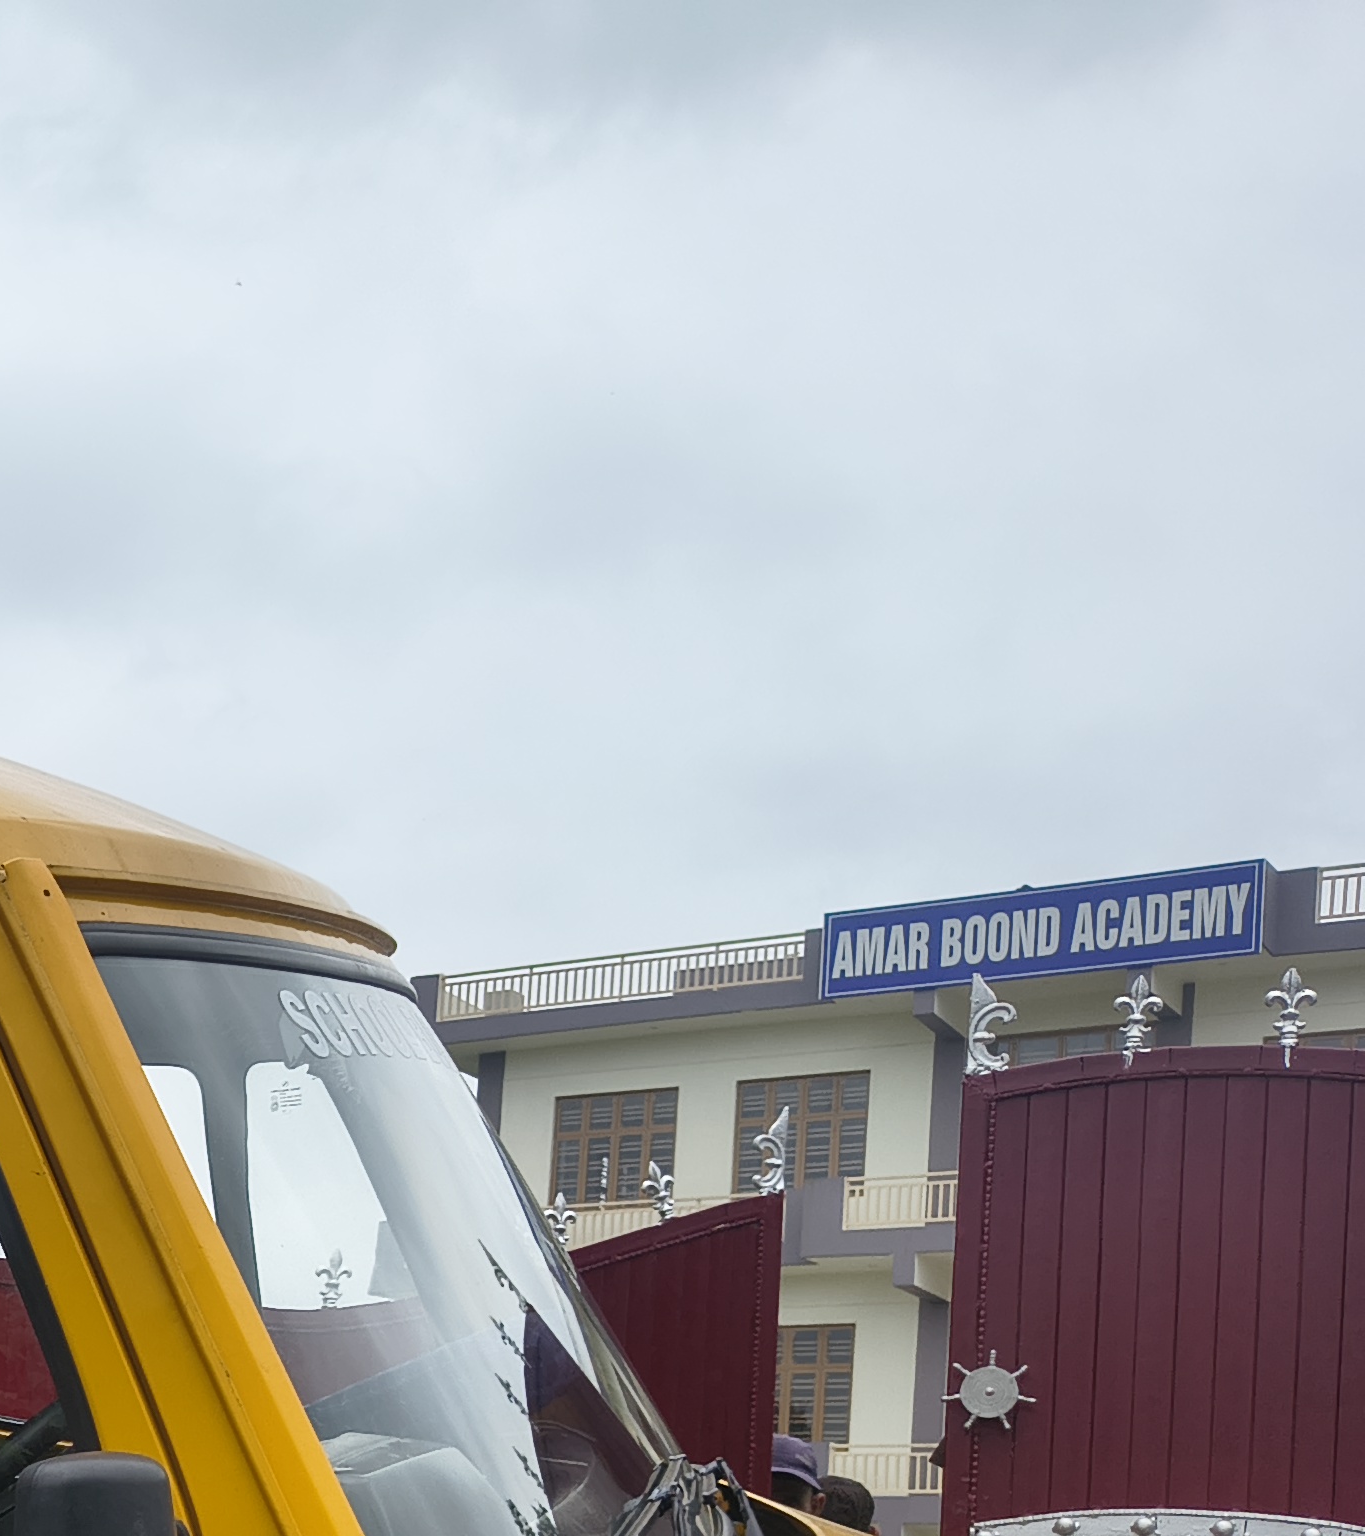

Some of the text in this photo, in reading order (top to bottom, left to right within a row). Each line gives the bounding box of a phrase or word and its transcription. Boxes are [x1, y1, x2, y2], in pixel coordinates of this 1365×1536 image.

[831, 882, 1251, 979] AMAR BOOND ACADEMY
